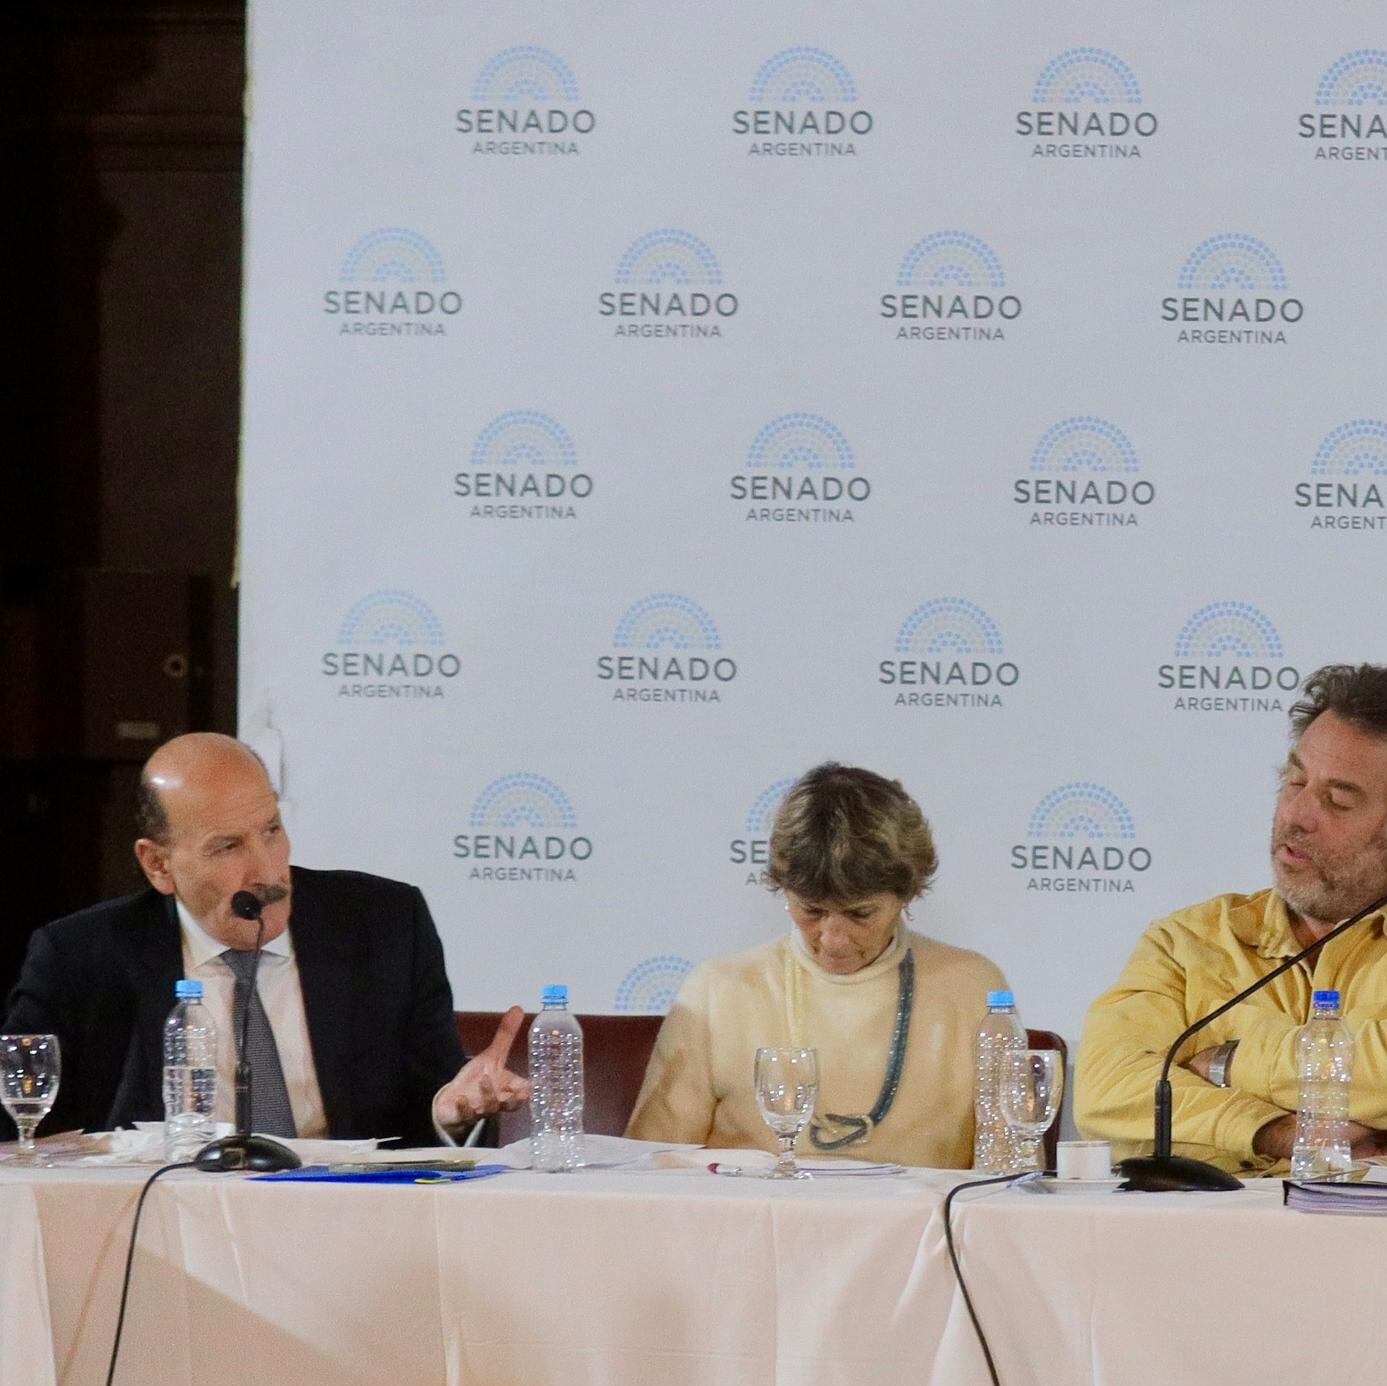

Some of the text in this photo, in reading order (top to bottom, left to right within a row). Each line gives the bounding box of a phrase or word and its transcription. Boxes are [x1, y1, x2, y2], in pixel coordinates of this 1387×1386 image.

[455, 108, 597, 135] SENADO
[732, 109, 874, 136] SENADO
[1015, 110, 1159, 138] SENADO
[472, 141, 580, 156] ARGENTINA
[748, 142, 857, 157] ARGENTINA
[1031, 143, 1142, 159] ARGENTINA
[323, 290, 463, 316] SENADO
[598, 291, 740, 318] SENADO
[879, 293, 1023, 321] SENADO
[1160, 296, 1305, 324] SENADO
[339, 322, 447, 337] ARGENTINA
[614, 323, 722, 338] ARGENTINA
[895, 326, 1005, 341] ARGENTINA
[1176, 329, 1287, 345] ARGENTINA
[453, 472, 594, 499] SENADO
[729, 474, 872, 502] SENADO
[1013, 478, 1156, 506] SENADO
[470, 504, 577, 519] ARGENTINA
[745, 507, 855, 523] ARGENTINA
[1029, 511, 1138, 527] ARGENTINA
[321, 652, 461, 678] SENADO
[596, 655, 738, 683] SENADO
[878, 659, 1020, 687] SENADO
[1157, 664, 1301, 692] SENADO
[338, 684, 444, 699] ARGENTINA
[613, 687, 721, 703] ARGENTINA
[894, 692, 1003, 708] ARGENTINA
[1173, 696, 1283, 712] ARGENTINA
[452, 834, 594, 862] SENADO
[1010, 844, 1153, 872] SENADO
[469, 866, 576, 882] ARGENTINA
[1026, 877, 1135, 893] ARGENTINA
